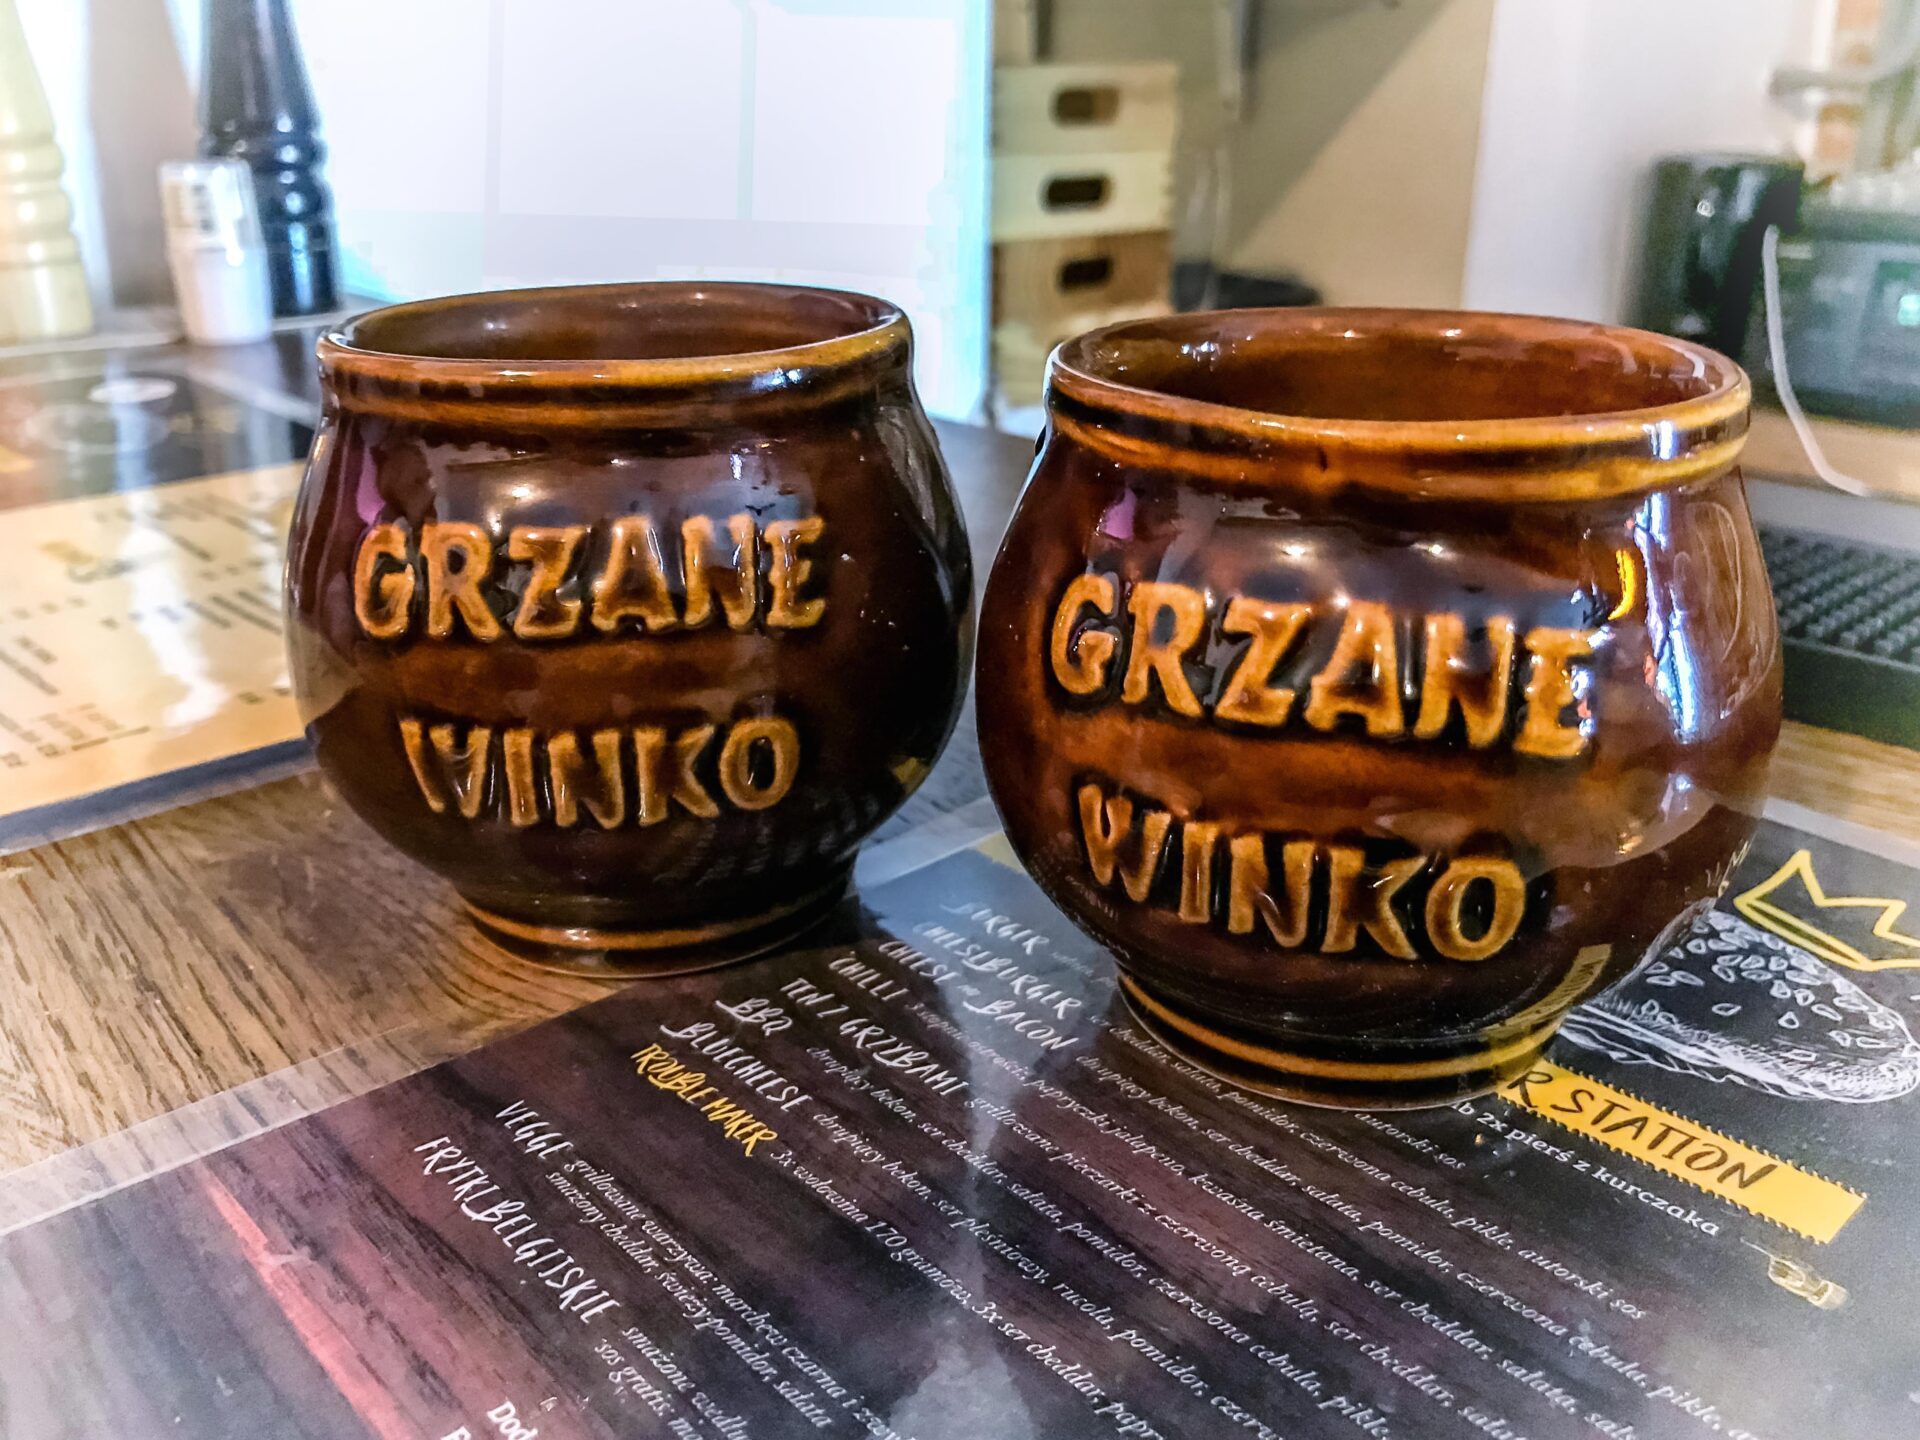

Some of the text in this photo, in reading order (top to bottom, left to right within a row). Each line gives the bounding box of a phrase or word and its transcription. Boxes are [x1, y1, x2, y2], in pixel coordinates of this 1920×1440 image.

[354, 514, 826, 639] GRZANE
[1051, 574, 1594, 757] GRZANE
[400, 715, 799, 828] WINKO
[1078, 784, 1527, 961] WINKO
[715, 997, 793, 1037] BBQ
[828, 957, 909, 1001] CHILLI
[878, 941, 959, 984] CHEESE
[660, 1022, 813, 1113] BLUECHEESE
[780, 977, 835, 1007] TEN
[838, 1018, 969, 1096] GRZYBAMI
[962, 999, 1079, 1050] BACON
[630, 1042, 778, 1158] TROUBLE MAKER
[1354, 1112, 1466, 1170] autorski sos
[1550, 1088, 1778, 1190] STATION
[413, 1136, 500, 1202] FRYTKI
[1300, 1130, 1392, 1181] czerwona
[1391, 1180, 1455, 1219] cebula,
[1450, 1217, 1513, 1250] pikle,
[1518, 1249, 1614, 1299] autorski
[1609, 1299, 1646, 1319] sos
[1476, 1112, 1721, 1237] 2x pierś z kurczaka
[545, 1171, 607, 1223] smażony
[600, 1222, 660, 1274] cheddar,
[654, 1272, 711, 1318] świeży
[694, 1317, 778, 1382] pomidor,
[773, 1380, 833, 1427] sałata
[563, 1159, 865, 1408] grillowane warzywa: marchew czarna i
[770, 1149, 1164, 1440] 3x wołowina 170 gramów, 3x ser cheddar, papr
[813, 1113, 886, 1163] chrupiący
[932, 1199, 964, 1217] ser
[949, 1218, 1050, 1284] pleśniowy,
[1052, 1282, 1115, 1330] rucola,
[1106, 1328, 1208, 1397] pomidor,
[917, 1122, 946, 1138] ser
[941, 1138, 1008, 1185] cheddar,
[1006, 1183, 1063, 1223] sałata,
[1056, 1222, 1147, 1278] pomidor,
[1148, 1277, 1251, 1343] czerwona
[1249, 1344, 1321, 1397] cebula,
[1022, 1079, 1116, 1128] papryczki
[1189, 1173, 1264, 1220] kwaśna
[1263, 1219, 1360, 1281] śmietana,
[1363, 1280, 1402, 1299] ser
[1400, 1300, 1494, 1361] cheddar,
[1496, 1359, 1577, 1415] sałata,
[1048, 1151, 1145, 1204] pieczarki
[1137, 1202, 1157, 1215] z
[1154, 1214, 1252, 1277] czerwoną
[1323, 1321, 1362, 1341] ser
[1360, 1342, 1455, 1407] cheddar,
[1200, 1127, 1232, 1142] ser
[1228, 1144, 1301, 1186] cheddar,
[1301, 1184, 1362, 1223] sałata,
[1357, 1220, 1454, 1274] pomidor,
[1457, 1271, 1568, 1336] czerwona
[1646, 1385, 1722, 1431] pikle,
[594, 1343, 675, 1417] sos gratis:
[621, 1326, 697, 1393] smażone
